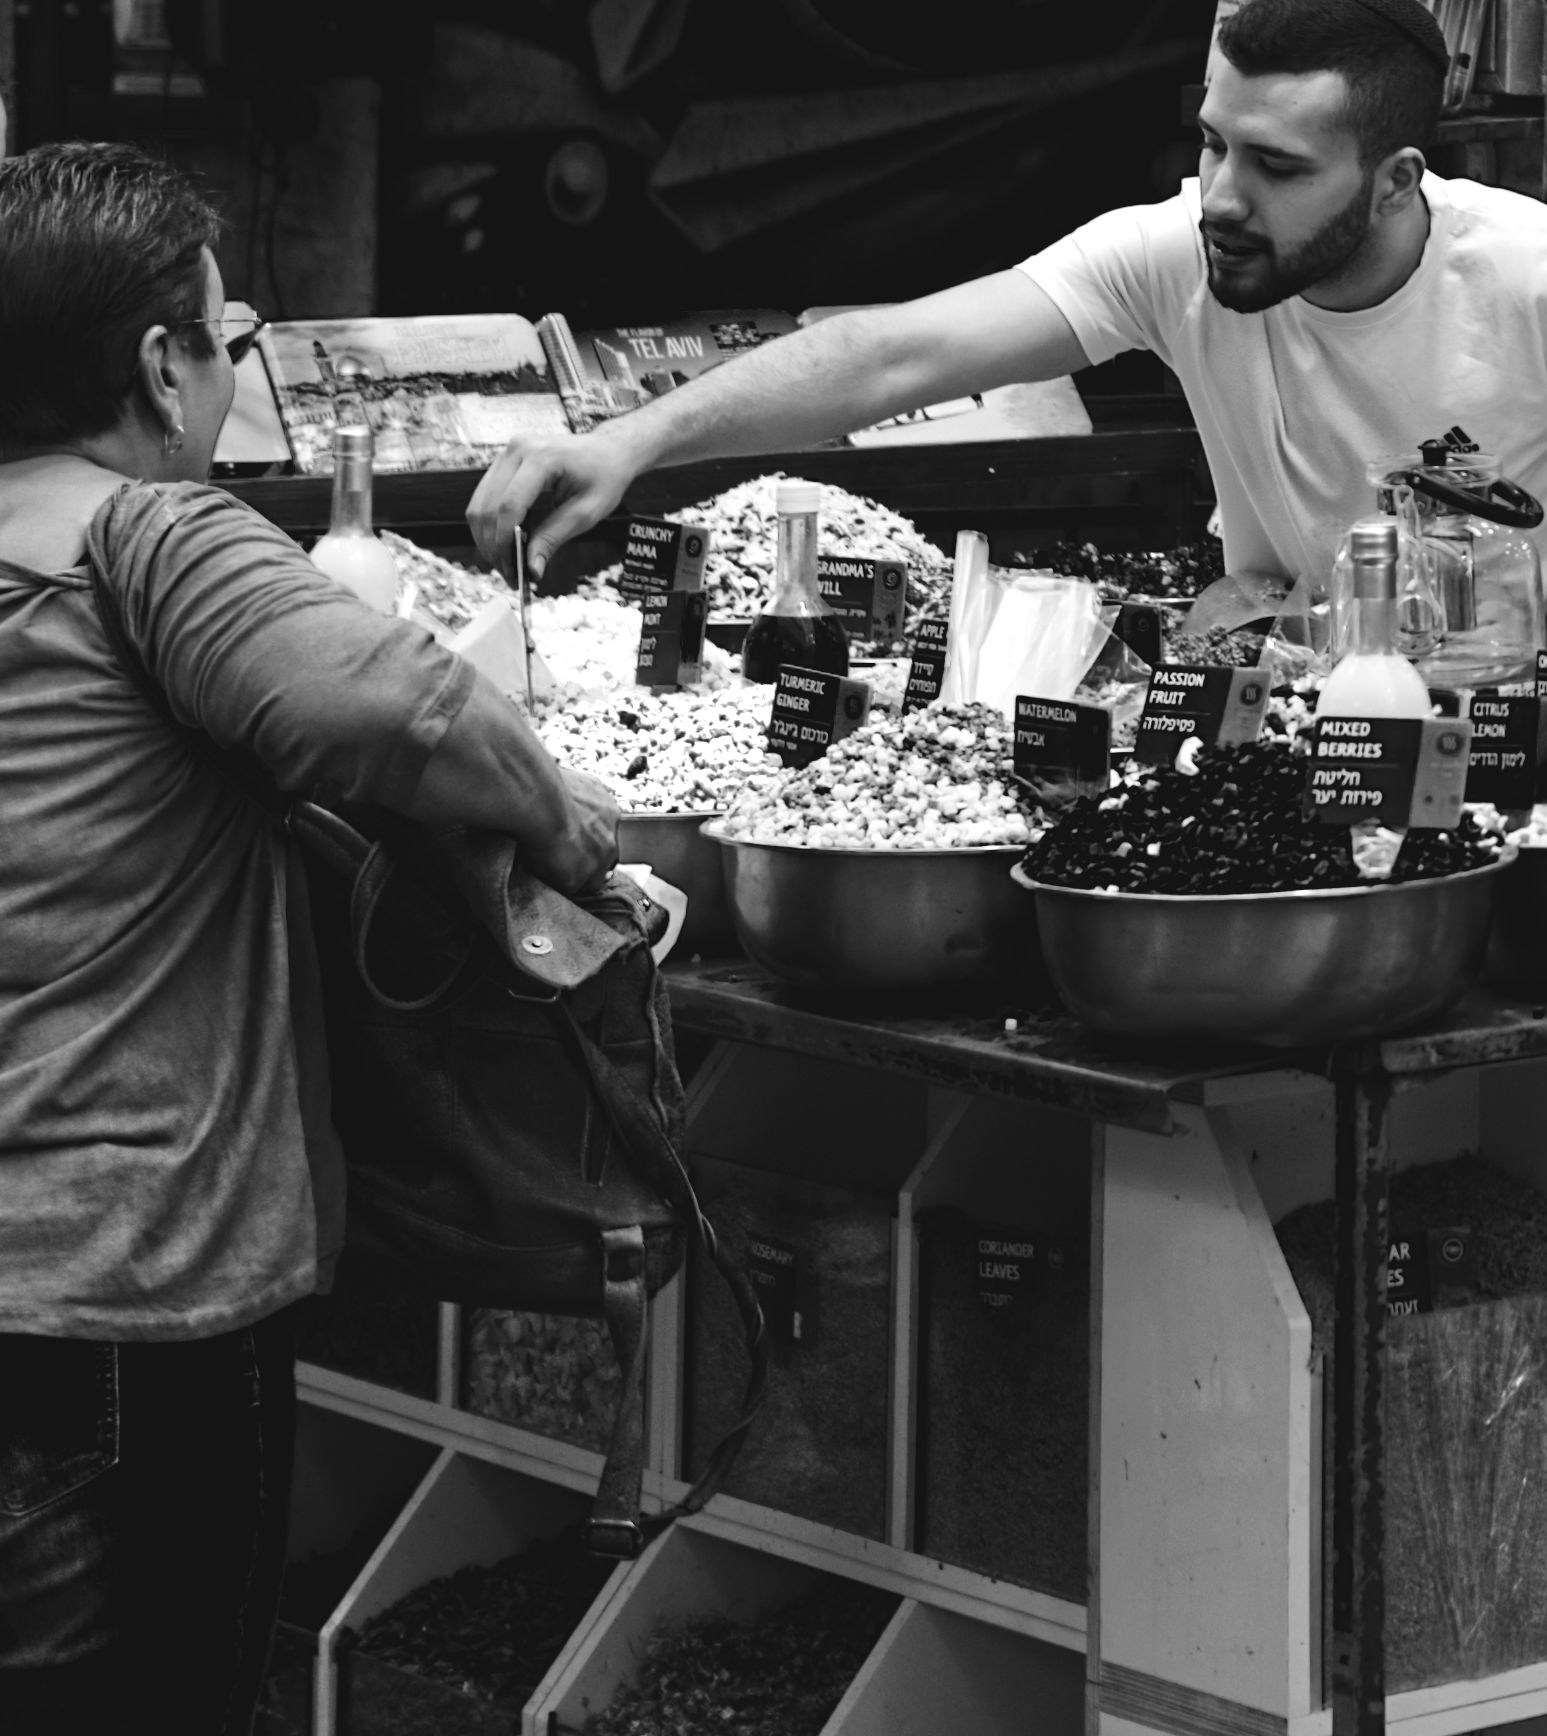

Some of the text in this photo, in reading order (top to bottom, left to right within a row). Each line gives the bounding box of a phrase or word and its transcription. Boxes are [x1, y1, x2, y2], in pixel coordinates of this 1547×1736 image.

[628, 335, 705, 360] TEL AVIV
[629, 522, 675, 544] CRUNCHY
[625, 542, 658, 560] MAMA
[920, 623, 946, 640] APPLE
[780, 672, 827, 695] TURMERIC
[1153, 670, 1206, 688] PASSION
[776, 694, 811, 713] GINGER
[1148, 689, 1188, 707] FRUIT
[1018, 701, 1078, 724] WATERMELON
[1473, 702, 1510, 718] CITRUS
[1142, 714, 1196, 733] פסיפלורה
[1319, 720, 1372, 738] MIXED
[1471, 723, 1507, 738] LEMON
[1316, 741, 1383, 759] BERRIES
[1312, 767, 1361, 786] חליטת
[1339, 789, 1383, 807] פירות
[977, 1238, 1035, 1261] CORIANDER
[977, 1261, 1021, 1282] LEAVES
